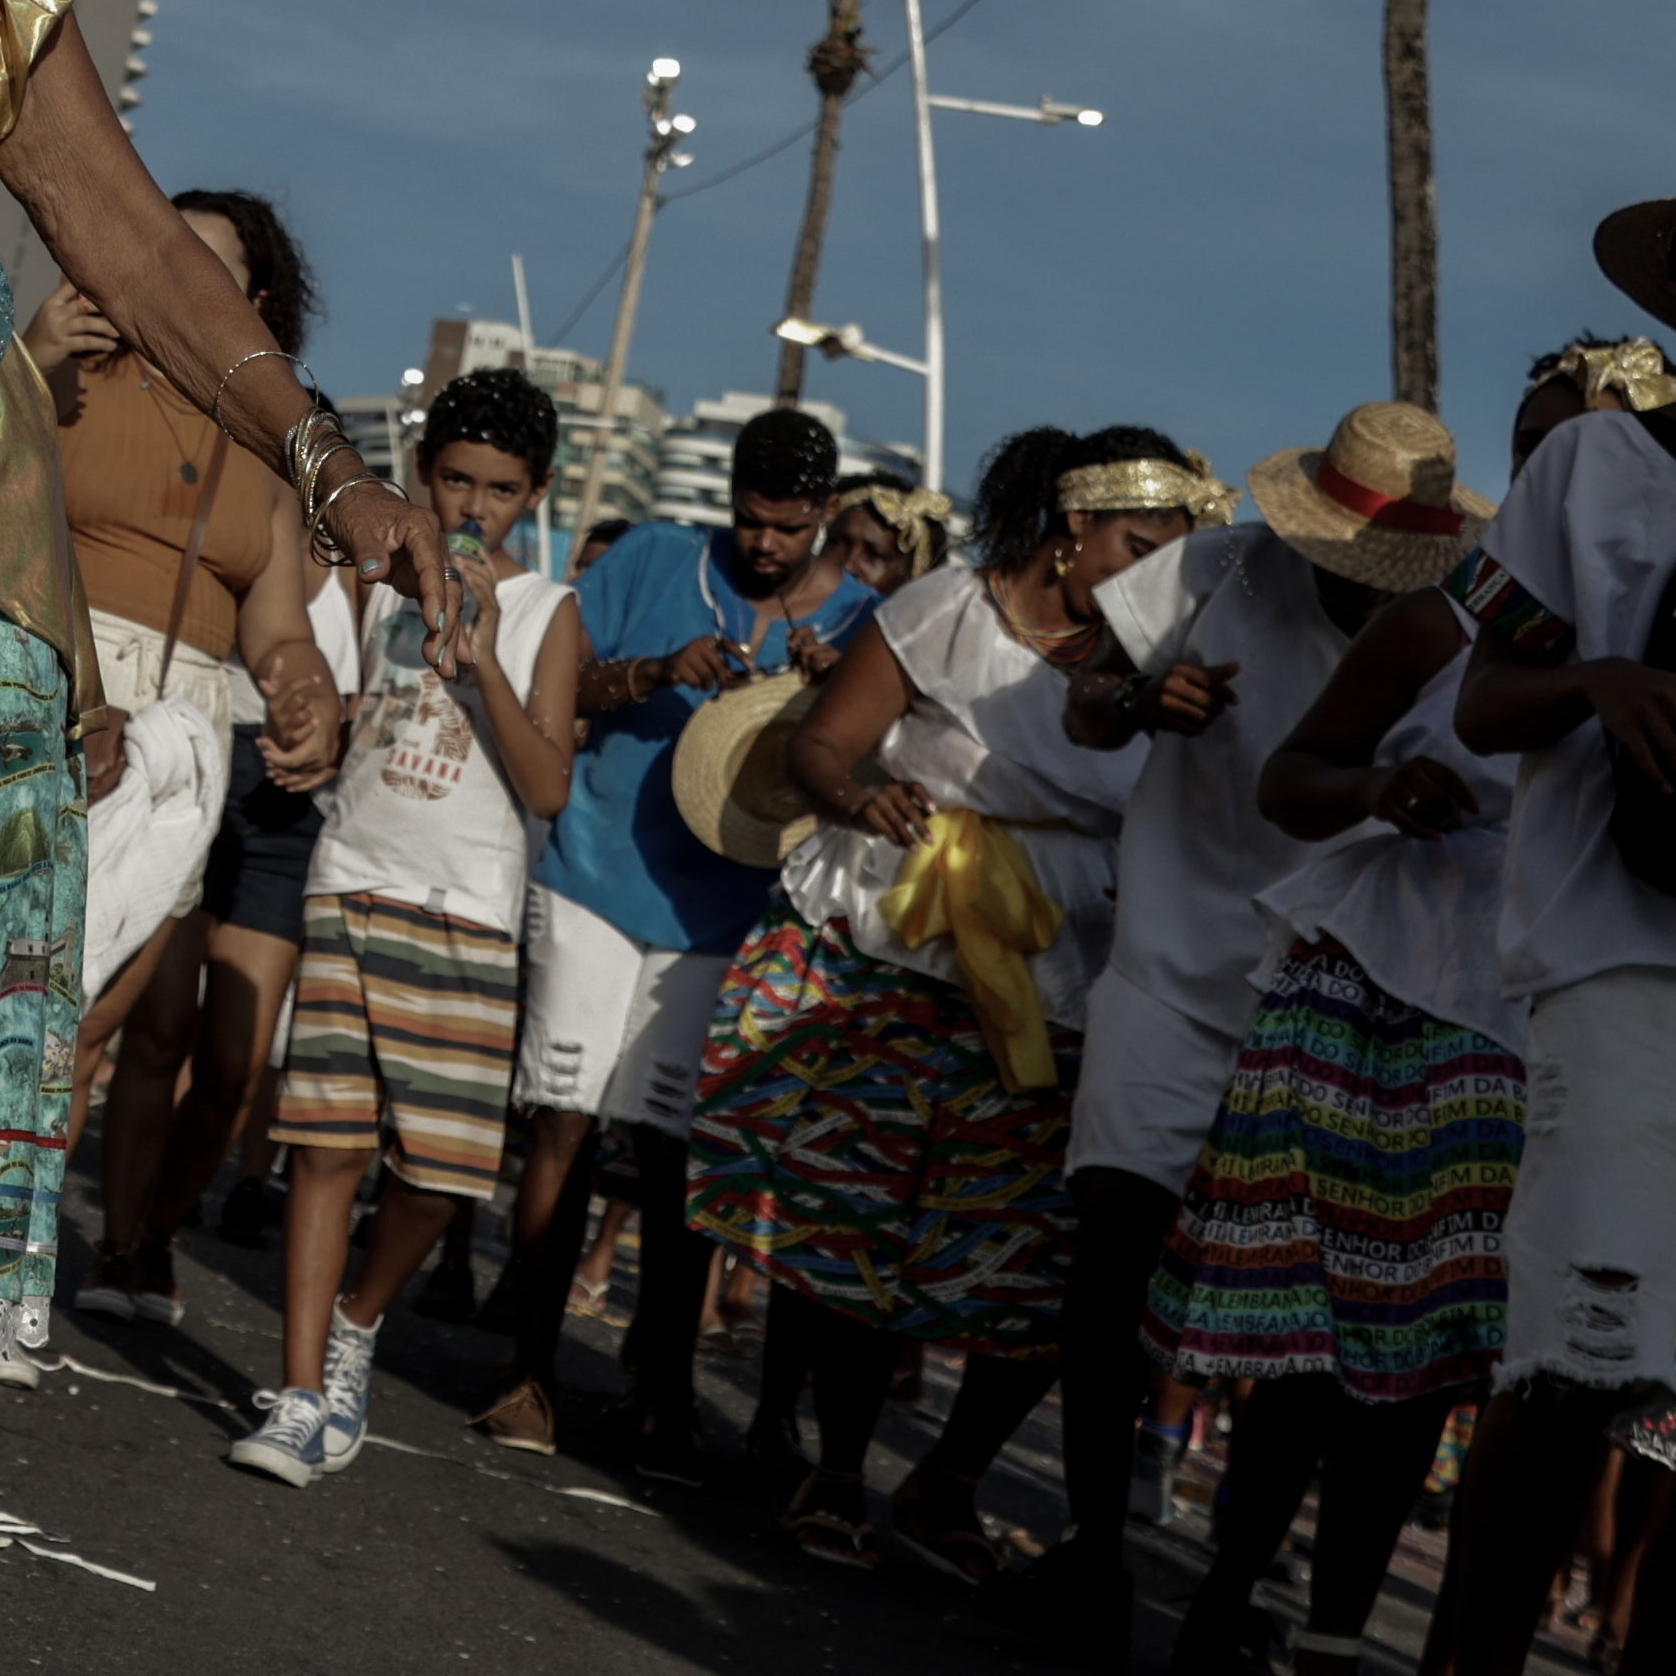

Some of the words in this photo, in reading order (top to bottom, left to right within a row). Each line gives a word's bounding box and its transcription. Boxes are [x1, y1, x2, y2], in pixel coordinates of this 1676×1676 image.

[387, 747, 462, 784] SAVANA
[17, 1037, 34, 1047] BAHIA
[1310, 1038, 1339, 1059] DO
[1300, 1080, 1327, 1101] DO
[1474, 1077, 1507, 1095] DA
[1475, 1099, 1508, 1118] DA
[1316, 1180, 1403, 1217] SENHOR
[1480, 1166, 1513, 1185] DA
